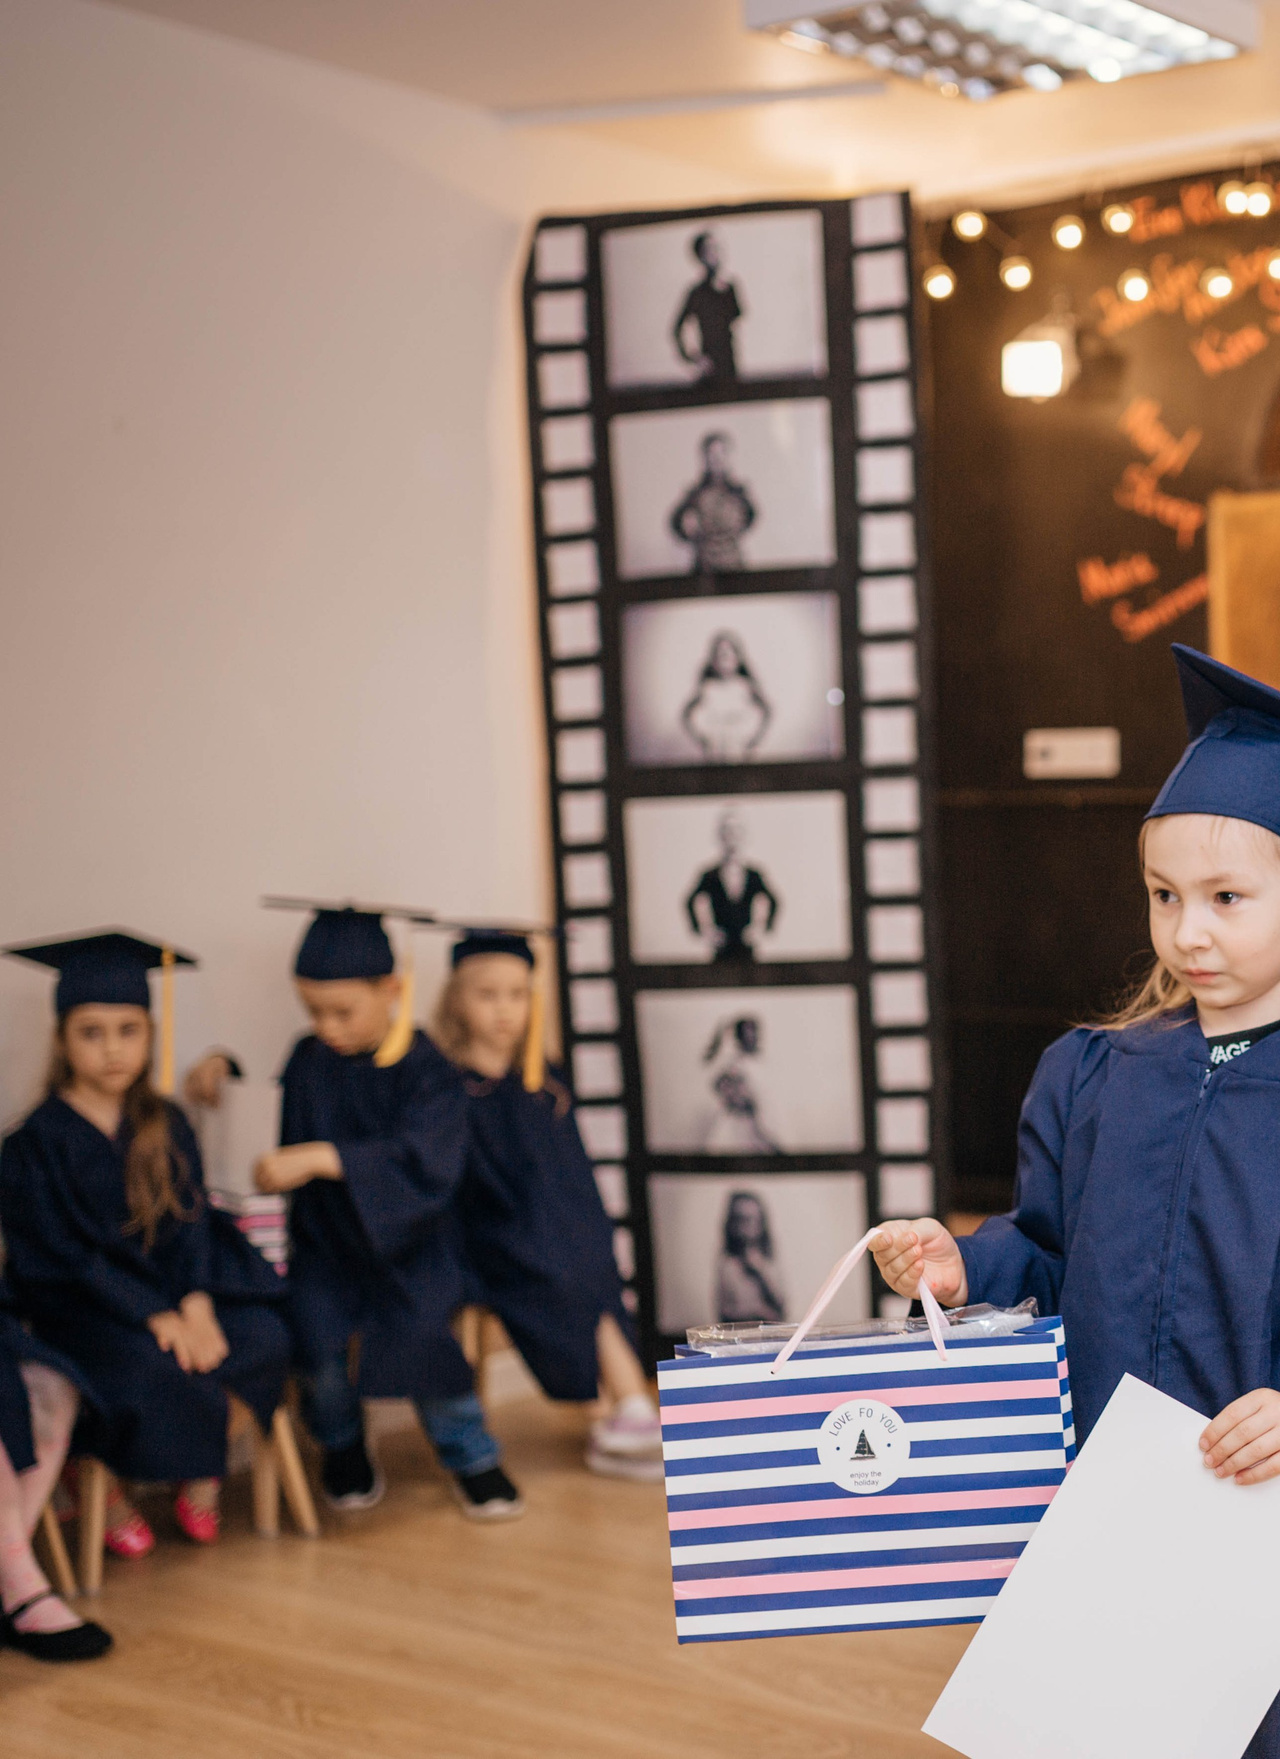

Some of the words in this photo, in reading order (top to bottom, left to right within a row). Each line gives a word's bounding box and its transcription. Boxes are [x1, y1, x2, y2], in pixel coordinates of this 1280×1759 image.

[829, 1411, 853, 1436] LOVE
[859, 1407, 874, 1418] FO
[879, 1413, 898, 1434] YOU
[849, 1471, 869, 1479] enjoy
[854, 1478, 879, 1486] holiday
